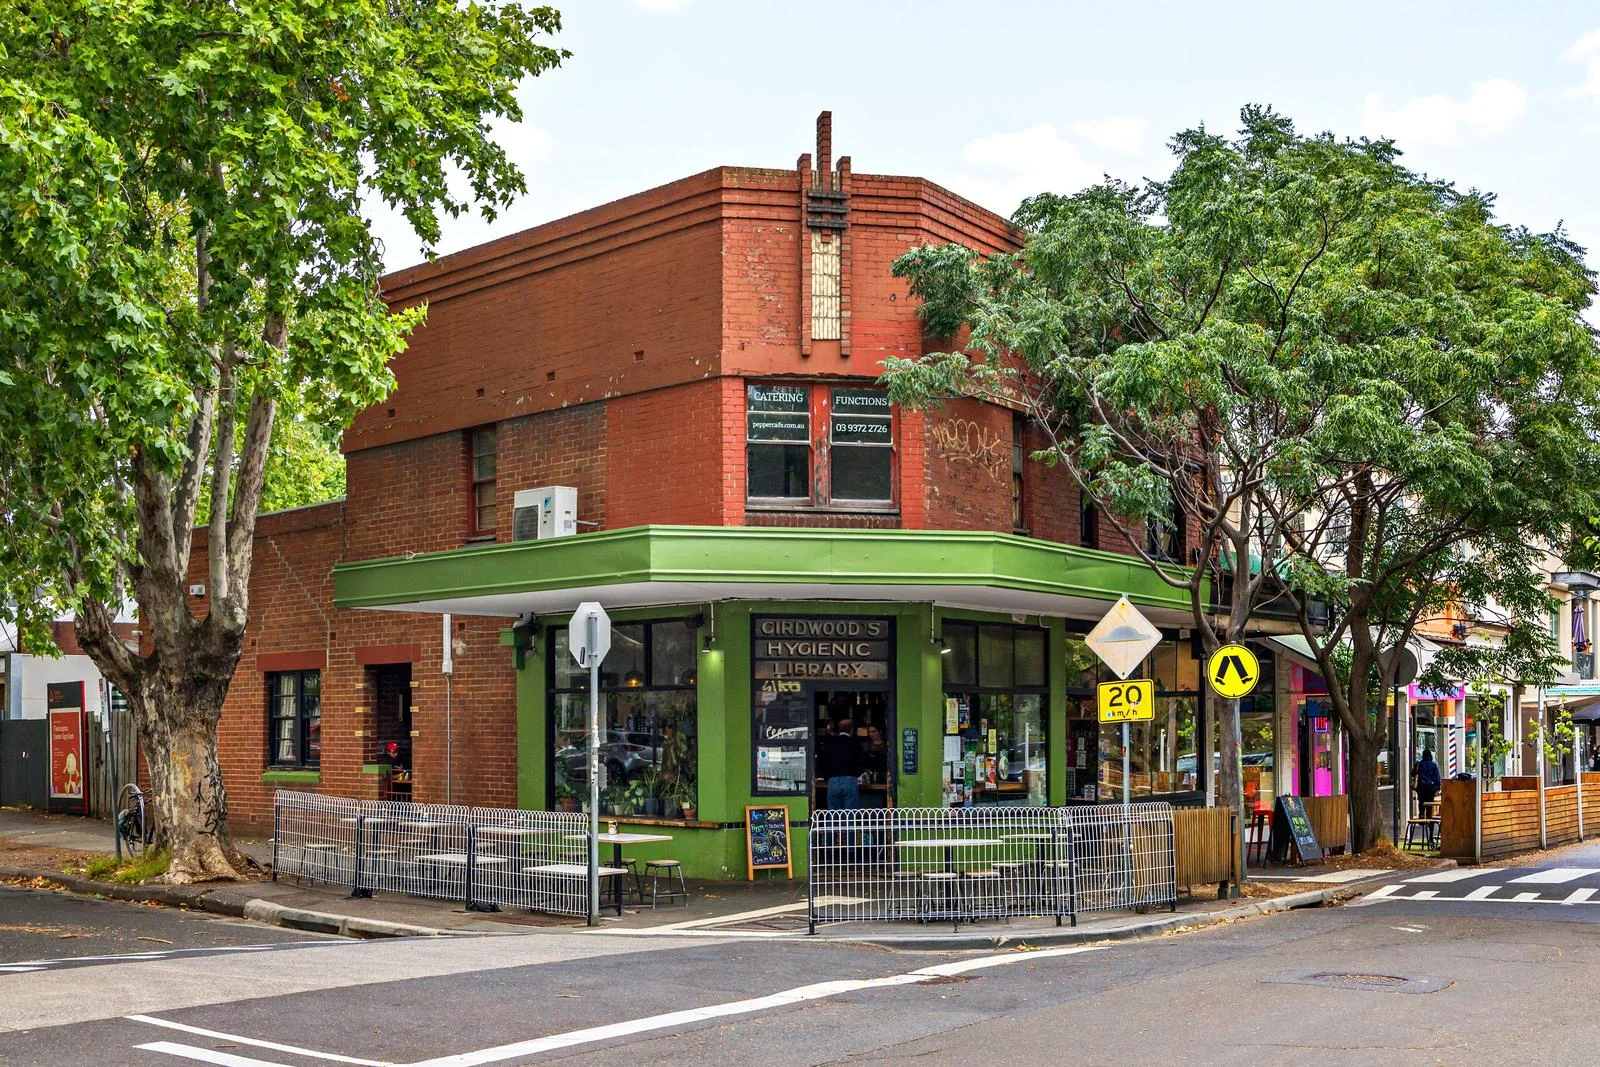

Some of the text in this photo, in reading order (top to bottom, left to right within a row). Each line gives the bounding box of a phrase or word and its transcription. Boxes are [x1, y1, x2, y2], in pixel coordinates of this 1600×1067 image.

[754, 392, 804, 403] CATERING
[835, 396, 888, 406] FUNCTIONS
[752, 421, 805, 430] peppercafe.com.au
[836, 423, 888, 433] 03 9372 2726
[761, 620, 881, 637] GIRDWOOD'S
[767, 642, 871, 657] HYGIENIC
[773, 662, 866, 677] LIBRARY
[1109, 685, 1142, 707] 20
[1111, 709, 1138, 717] km/h
